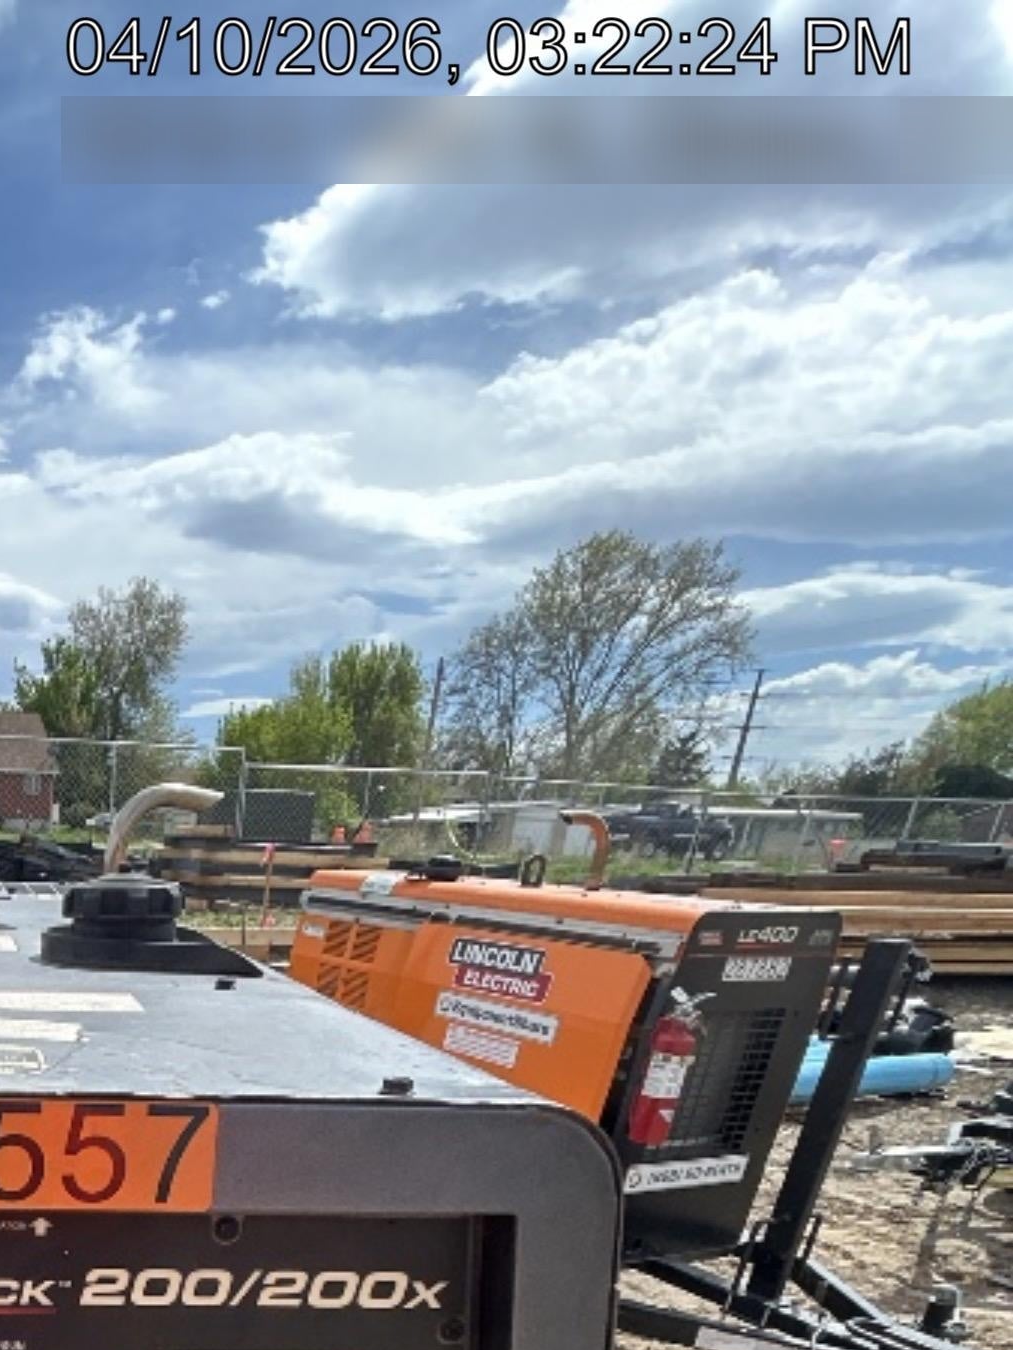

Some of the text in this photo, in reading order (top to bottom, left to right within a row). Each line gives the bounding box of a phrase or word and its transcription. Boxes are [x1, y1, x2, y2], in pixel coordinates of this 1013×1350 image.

[452, 941, 540, 974] LINCOLN
[463, 967, 541, 997] ELECTRIC
[79, 1267, 449, 1309] 200/200x
